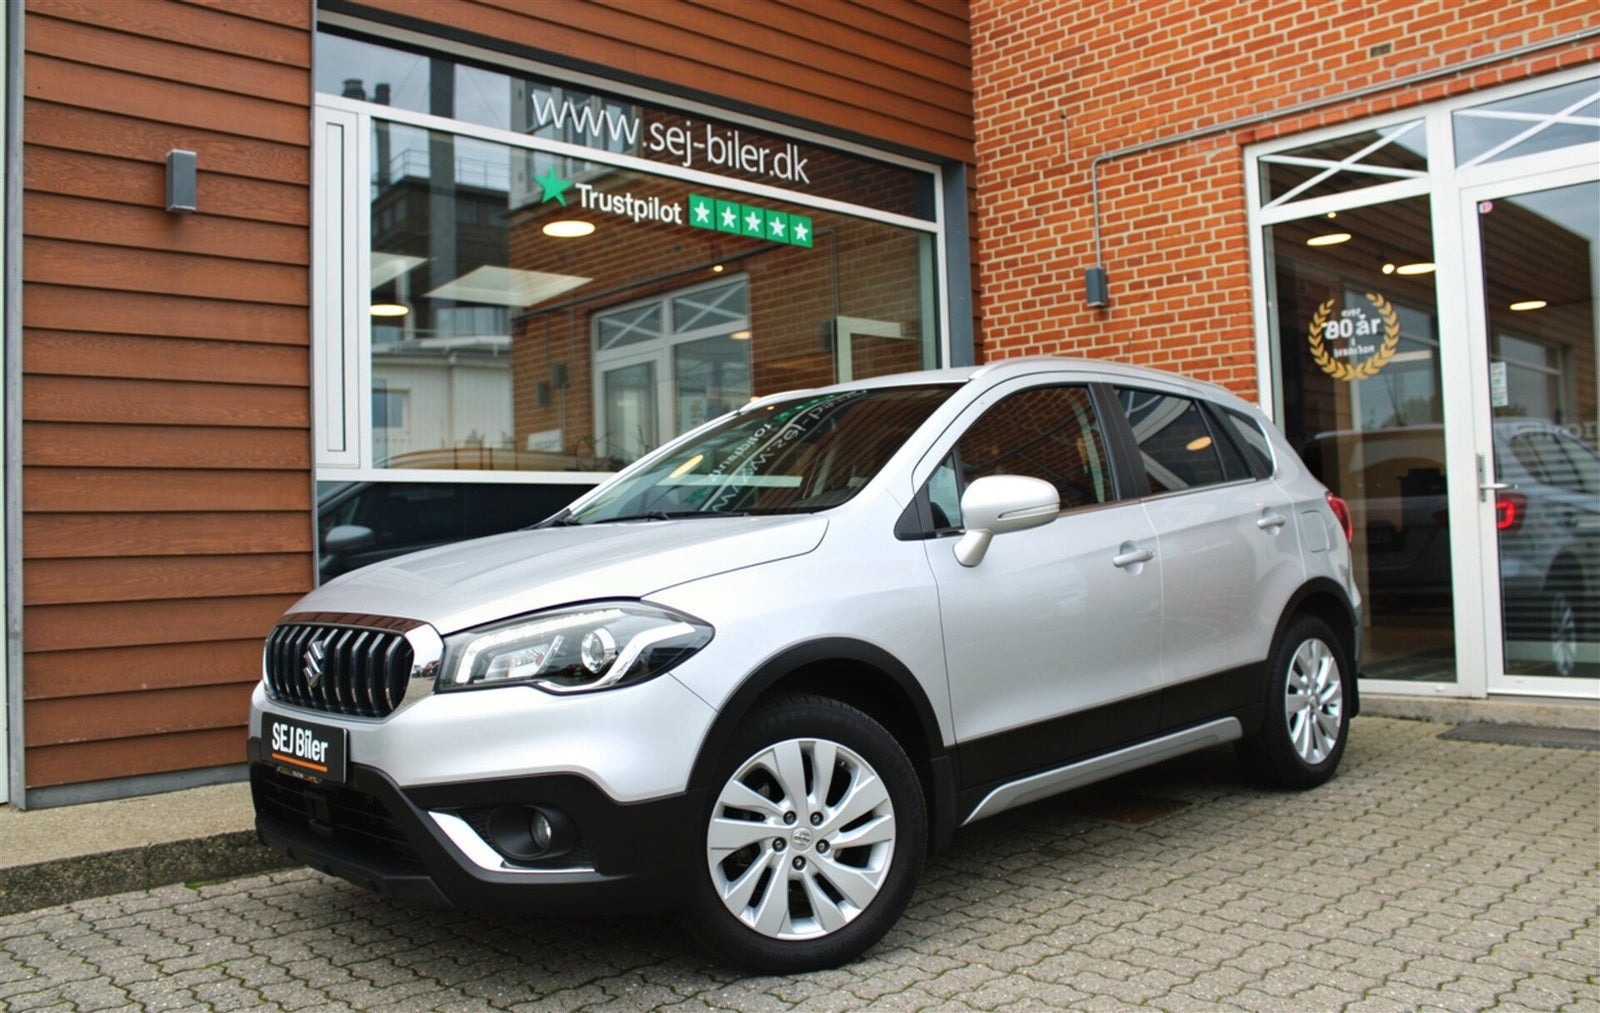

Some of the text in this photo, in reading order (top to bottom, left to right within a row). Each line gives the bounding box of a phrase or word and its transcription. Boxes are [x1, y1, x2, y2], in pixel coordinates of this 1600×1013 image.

[532, 93, 811, 184] www.sej-biler.dk
[575, 182, 683, 224] Trustpilot
[1324, 313, 1381, 340] 80 år
[271, 722, 329, 763] SEJ Biler
